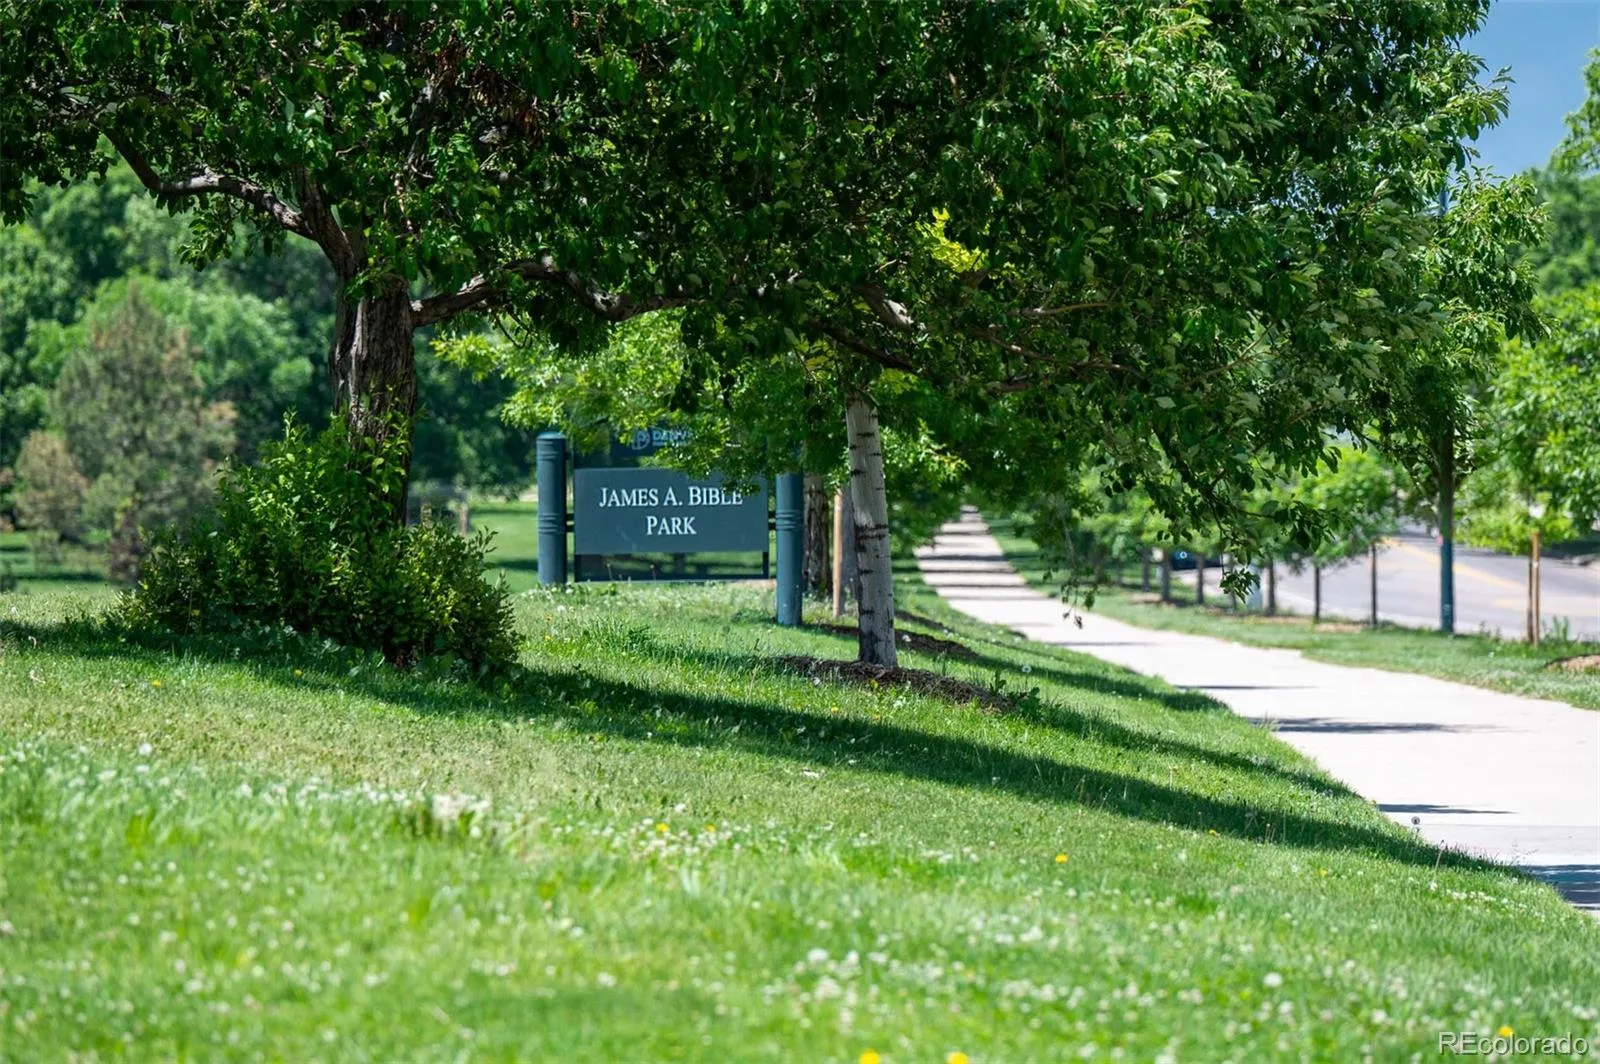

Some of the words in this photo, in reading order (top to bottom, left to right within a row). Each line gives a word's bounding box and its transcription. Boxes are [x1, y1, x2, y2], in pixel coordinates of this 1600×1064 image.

[599, 487, 658, 507] JAMES
[663, 486, 683, 506] A.
[688, 486, 743, 506] BIBLE
[645, 516, 697, 535] PARK
